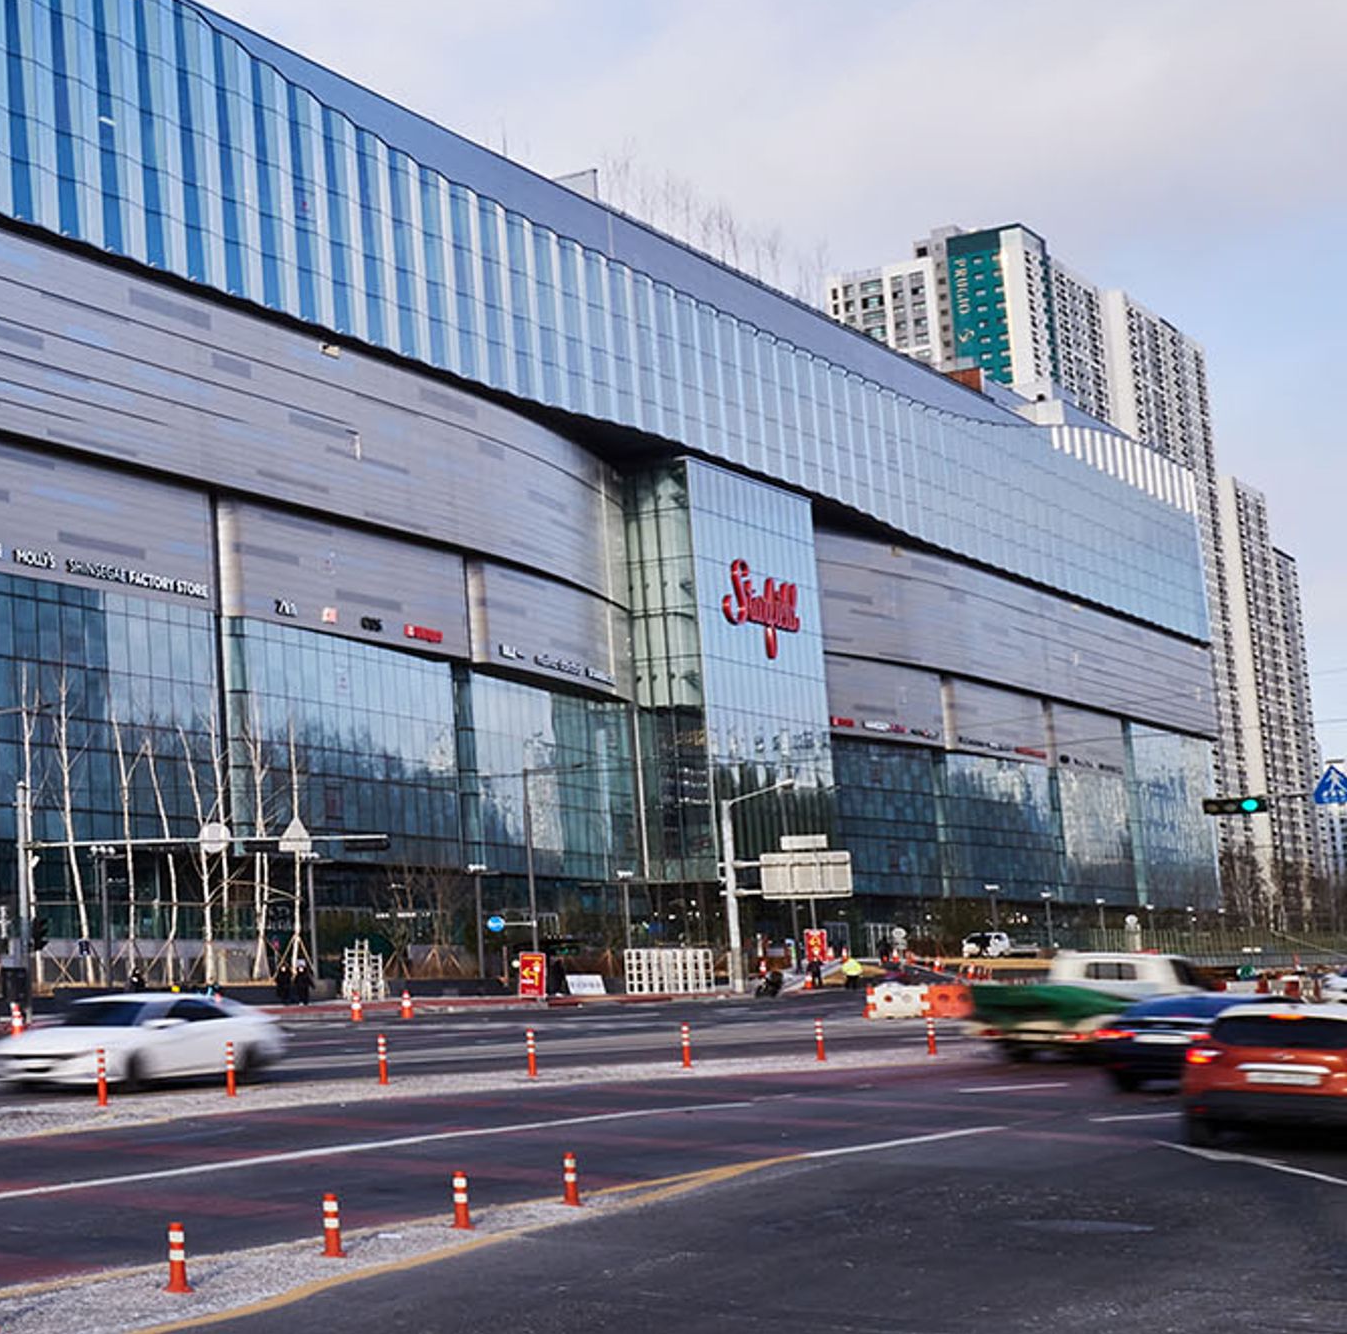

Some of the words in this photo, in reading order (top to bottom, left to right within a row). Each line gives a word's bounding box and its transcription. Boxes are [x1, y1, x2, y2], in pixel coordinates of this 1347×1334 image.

[128, 569, 175, 593] FACTORY
[175, 578, 210, 600] STORE
[722, 558, 800, 661] Starfield
